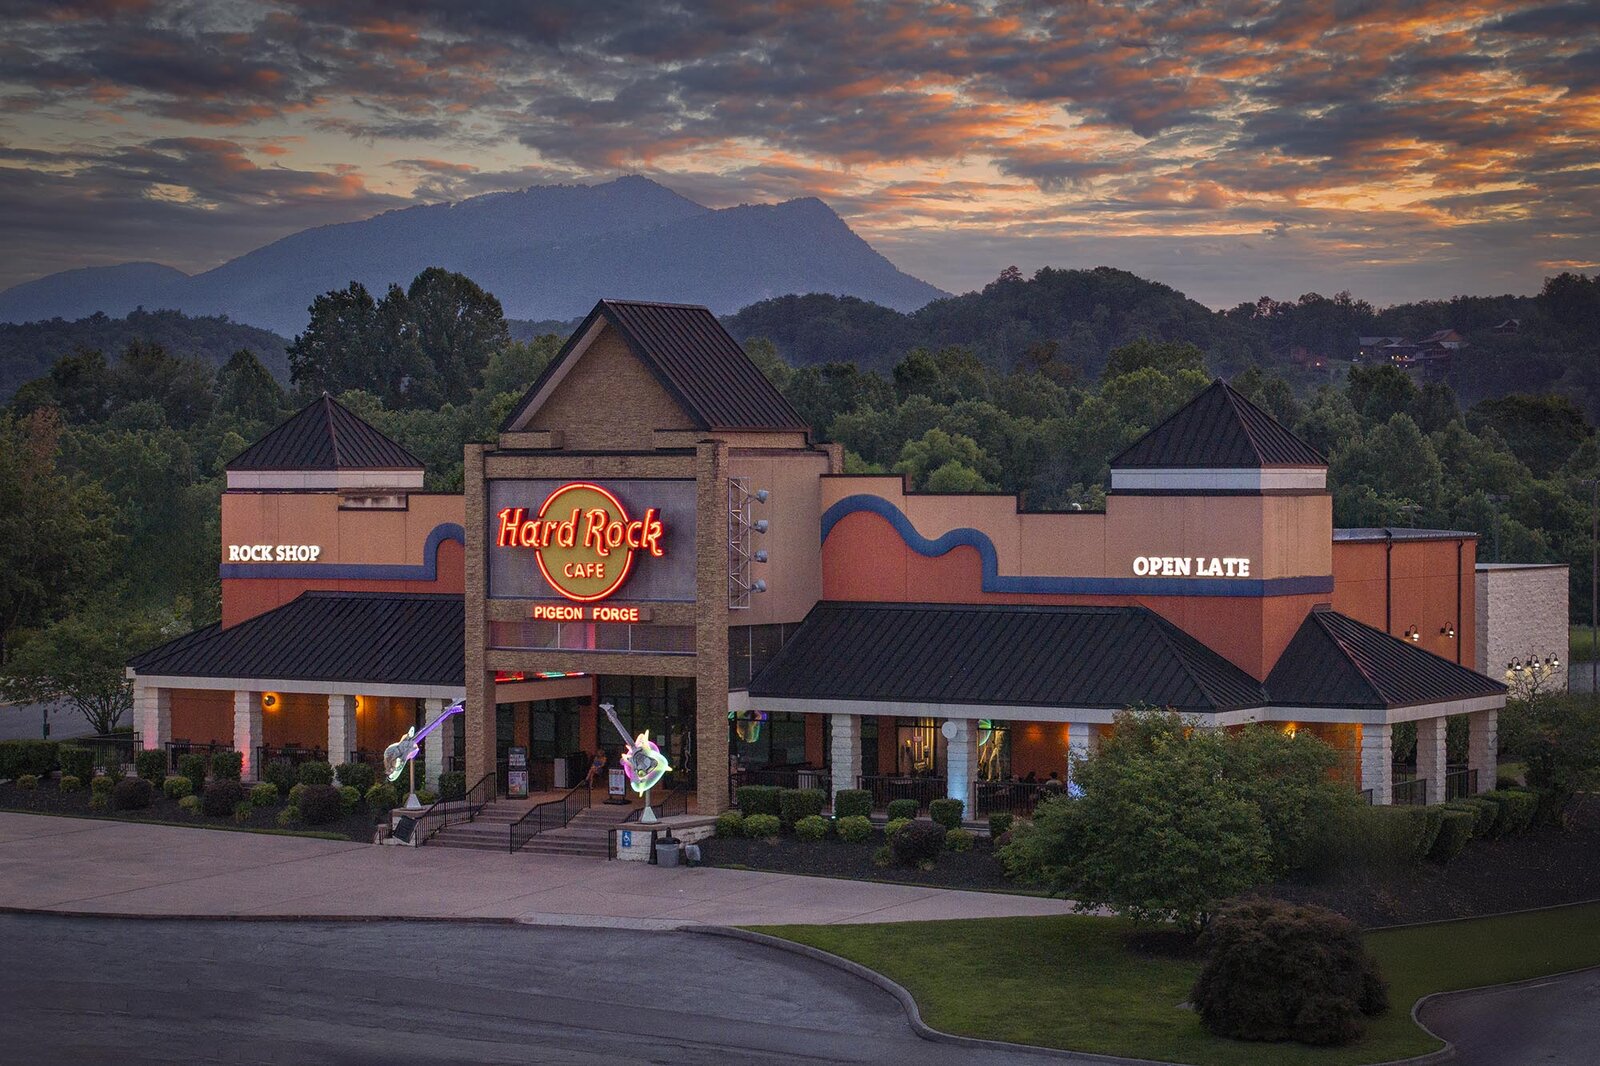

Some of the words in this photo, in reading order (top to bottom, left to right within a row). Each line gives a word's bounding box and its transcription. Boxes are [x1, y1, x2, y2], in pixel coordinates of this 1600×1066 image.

[497, 508, 581, 547] Hard
[584, 508, 664, 556] Rock
[229, 545, 273, 561] ROCK
[276, 545, 320, 561] SHOP
[564, 563, 604, 578] CAFE
[1133, 557, 1191, 576] OPEN
[1196, 558, 1250, 577] LATE
[534, 606, 583, 620] PIGEON
[592, 607, 638, 621] FORGE
